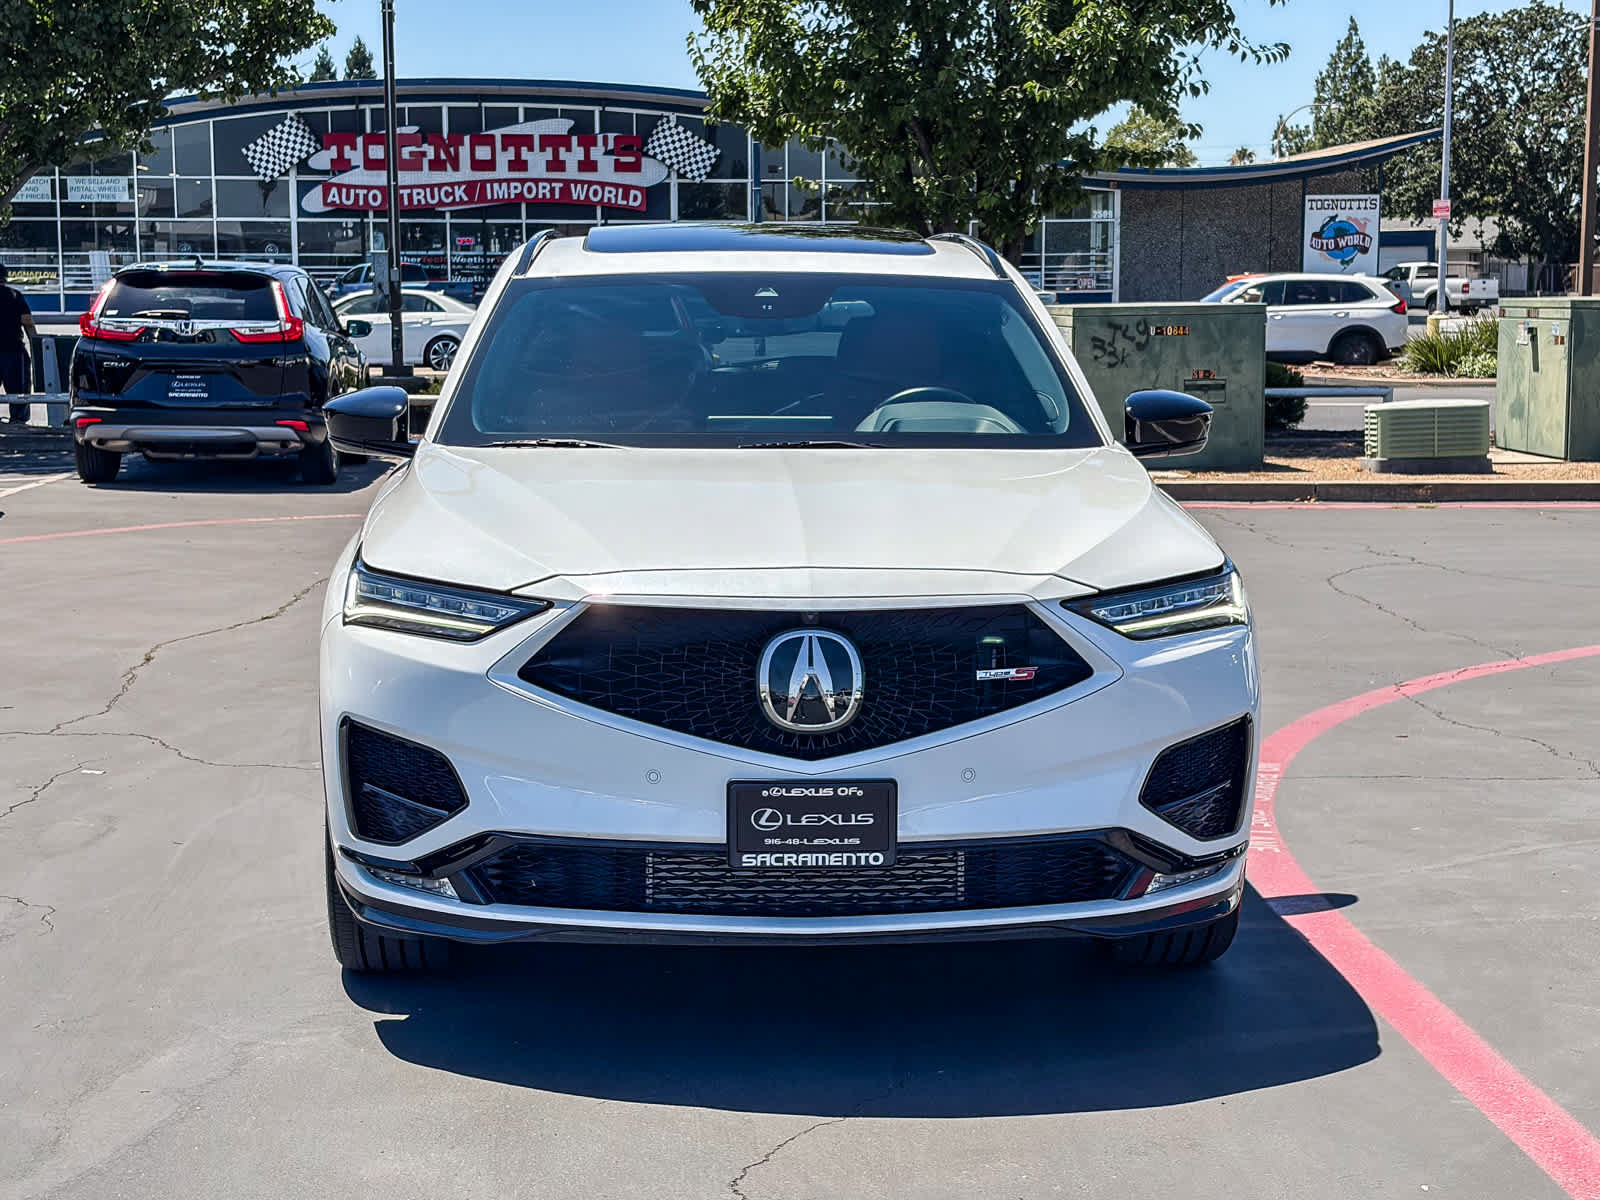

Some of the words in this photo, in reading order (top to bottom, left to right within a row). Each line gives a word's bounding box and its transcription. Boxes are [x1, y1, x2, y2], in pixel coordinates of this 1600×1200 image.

[322, 132, 643, 173] TOGNOTTI'S
[327, 186, 382, 207] AUTO
[400, 183, 470, 206] TRUCK
[486, 182, 563, 201] IMPORT
[570, 183, 642, 207] WORLD
[1307, 196, 1378, 211] TOGNOTTI'S
[1311, 238, 1335, 250] AUTO
[1337, 233, 1371, 249] WORLD
[782, 786, 834, 797] LEXUS
[837, 786, 858, 796] OF
[786, 813, 874, 826] LEXUS
[764, 837, 861, 845] 916-48-LEXUS
[741, 851, 884, 867] SACRAMENTO
